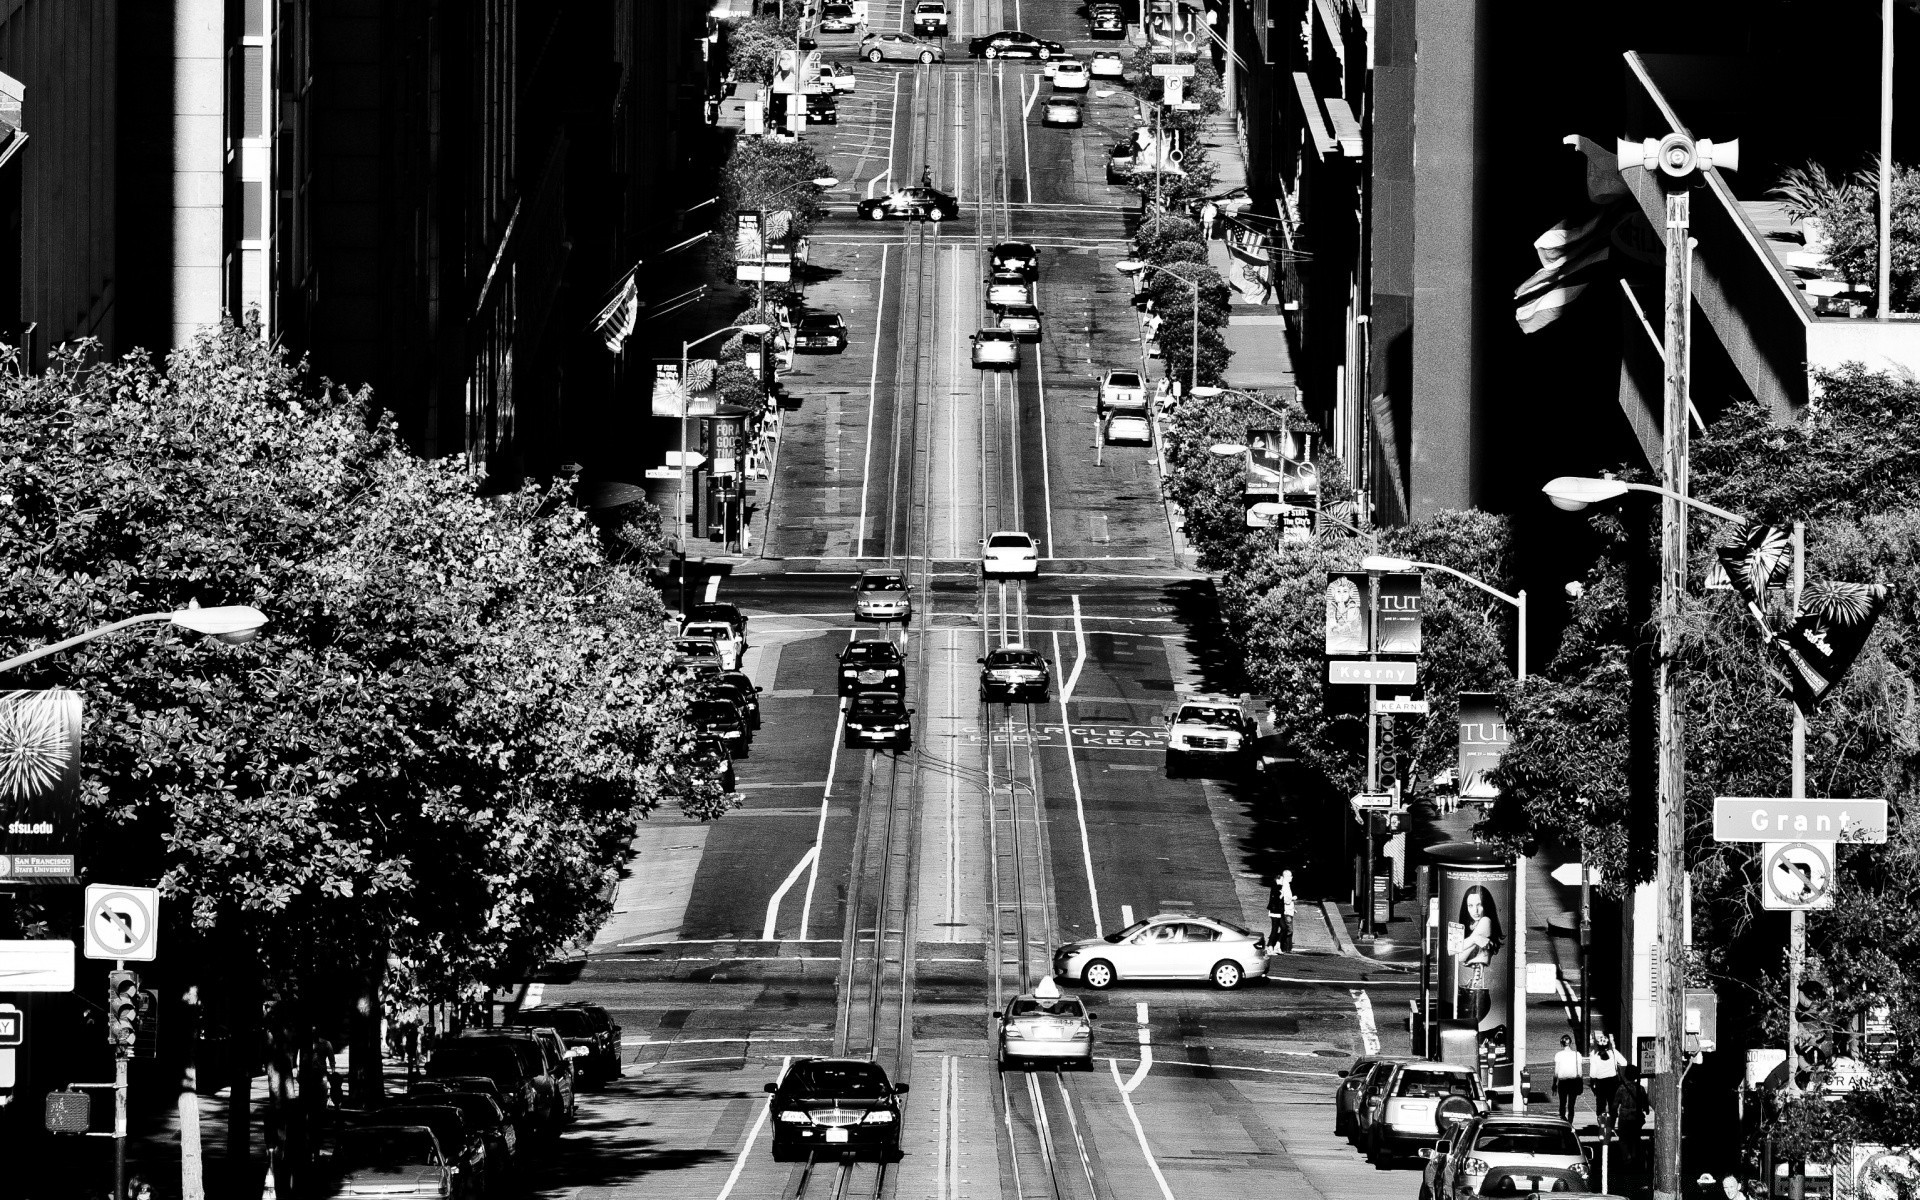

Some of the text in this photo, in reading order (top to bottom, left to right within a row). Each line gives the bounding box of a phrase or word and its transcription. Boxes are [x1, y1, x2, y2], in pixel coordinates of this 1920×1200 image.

[716, 424, 734, 436] FOR
[1380, 595, 1421, 609] TUT
[1340, 666, 1405, 682] Kearny
[1083, 737, 1165, 746] KEEP
[8, 820, 54, 834] sfsu.edu
[1751, 809, 1852, 832] Grant
[14, 857, 71, 865] SAN FRANCISCO
[1747, 1051, 1758, 1061] NO
